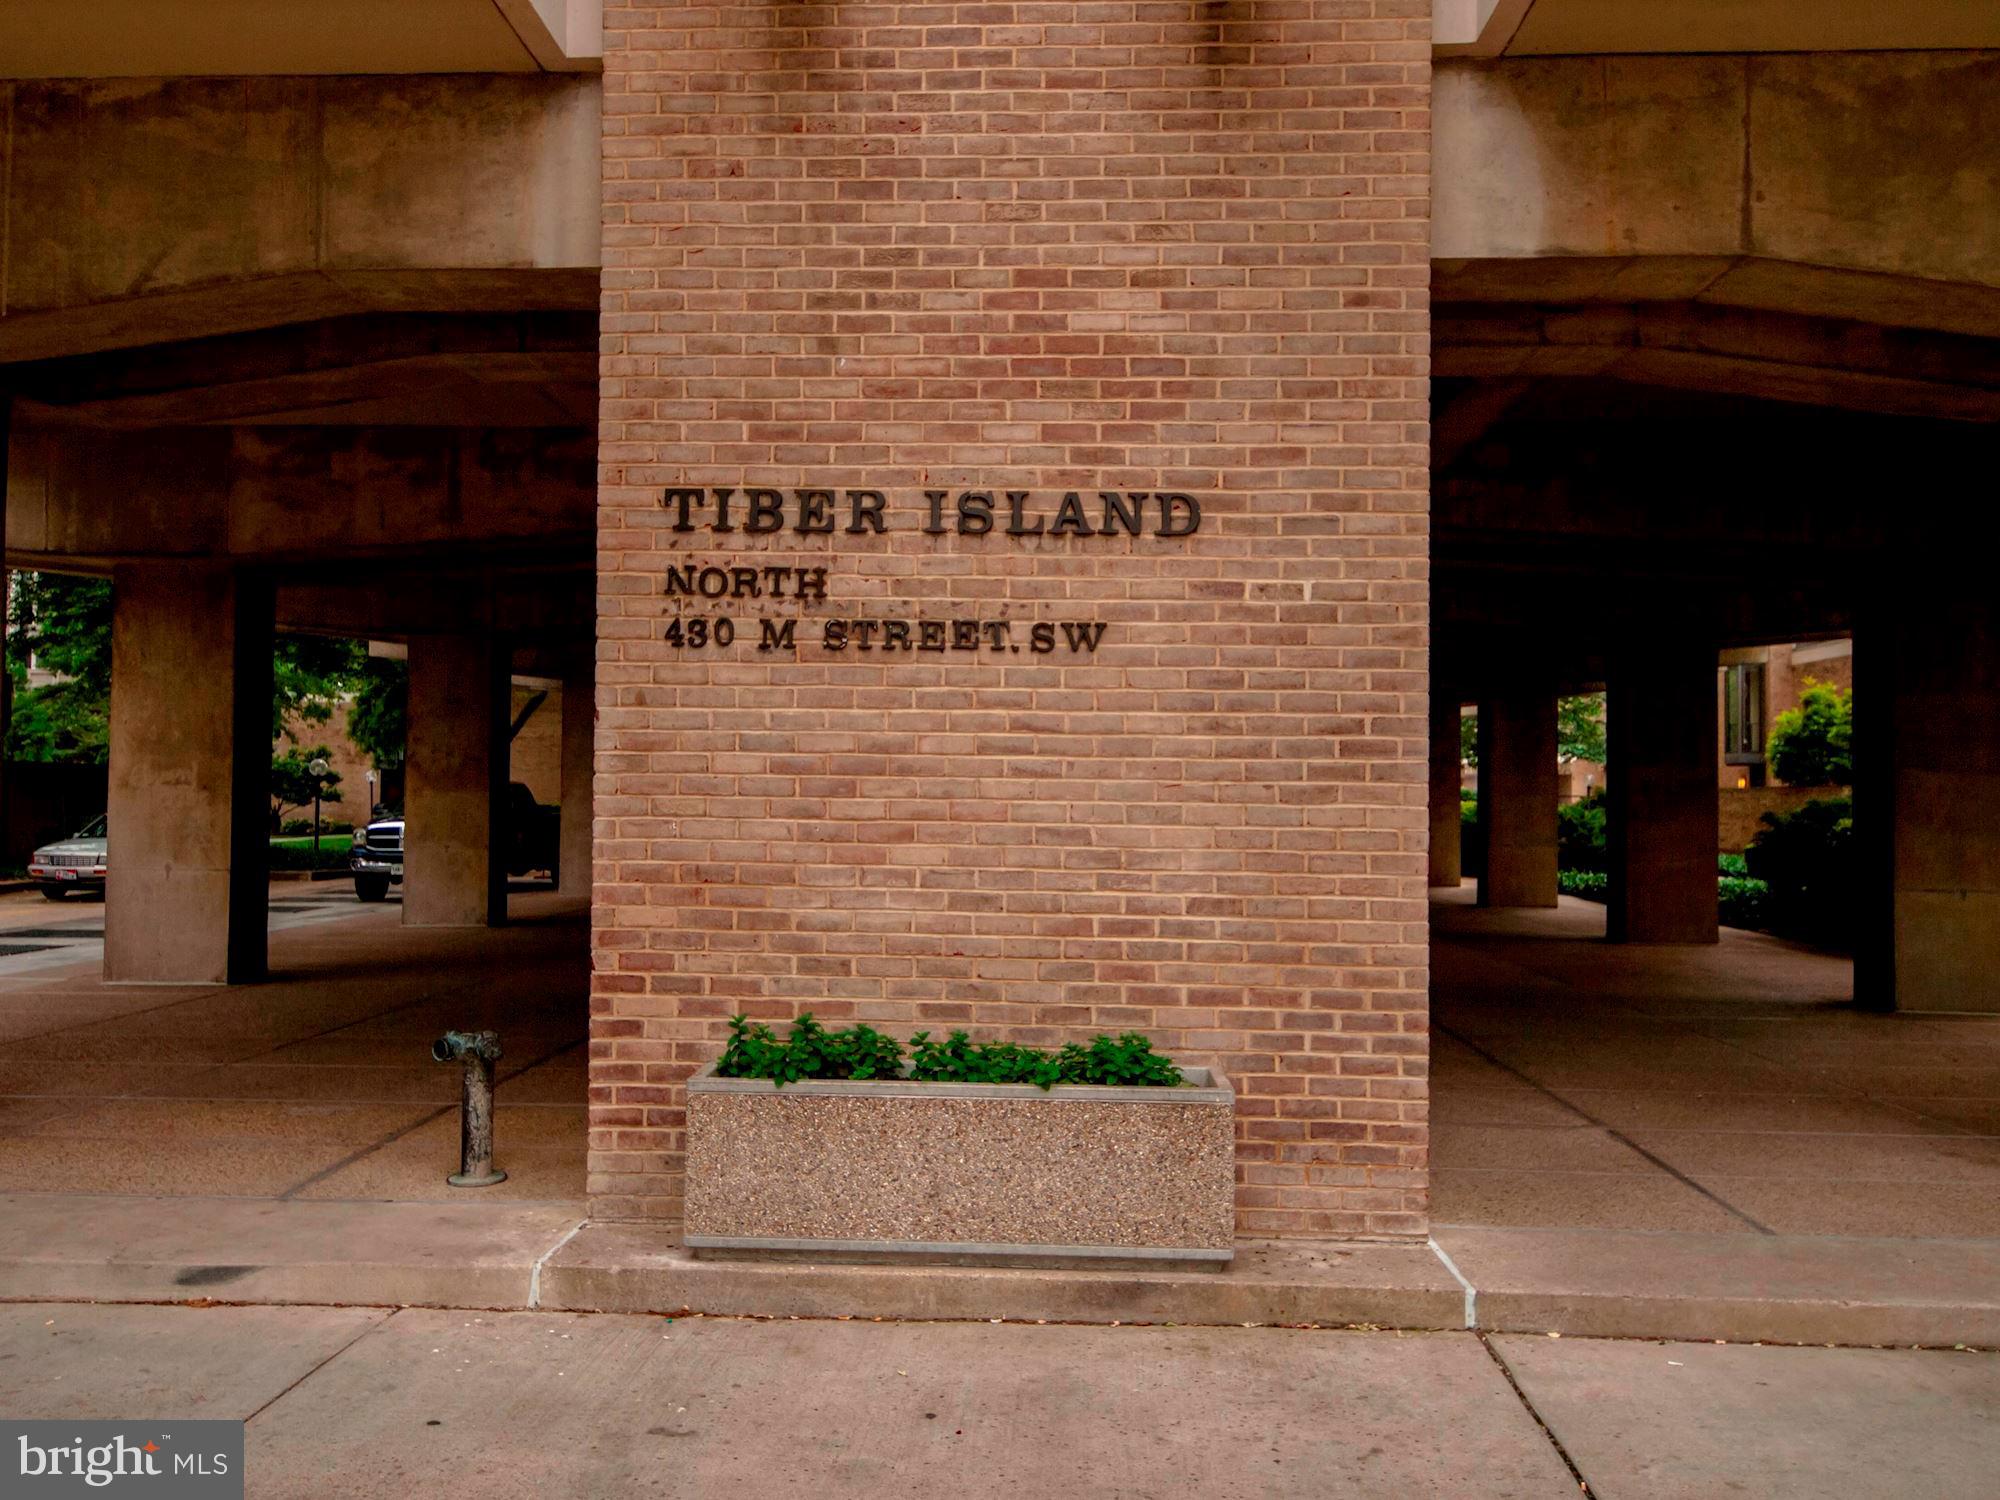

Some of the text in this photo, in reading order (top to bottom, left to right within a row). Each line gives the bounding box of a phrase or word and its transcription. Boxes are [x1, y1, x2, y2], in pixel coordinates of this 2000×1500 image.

[664, 488, 1202, 537] TIBER ISLAND
[664, 564, 828, 599] NORTH
[664, 617, 735, 649] 430
[758, 618, 798, 650] M
